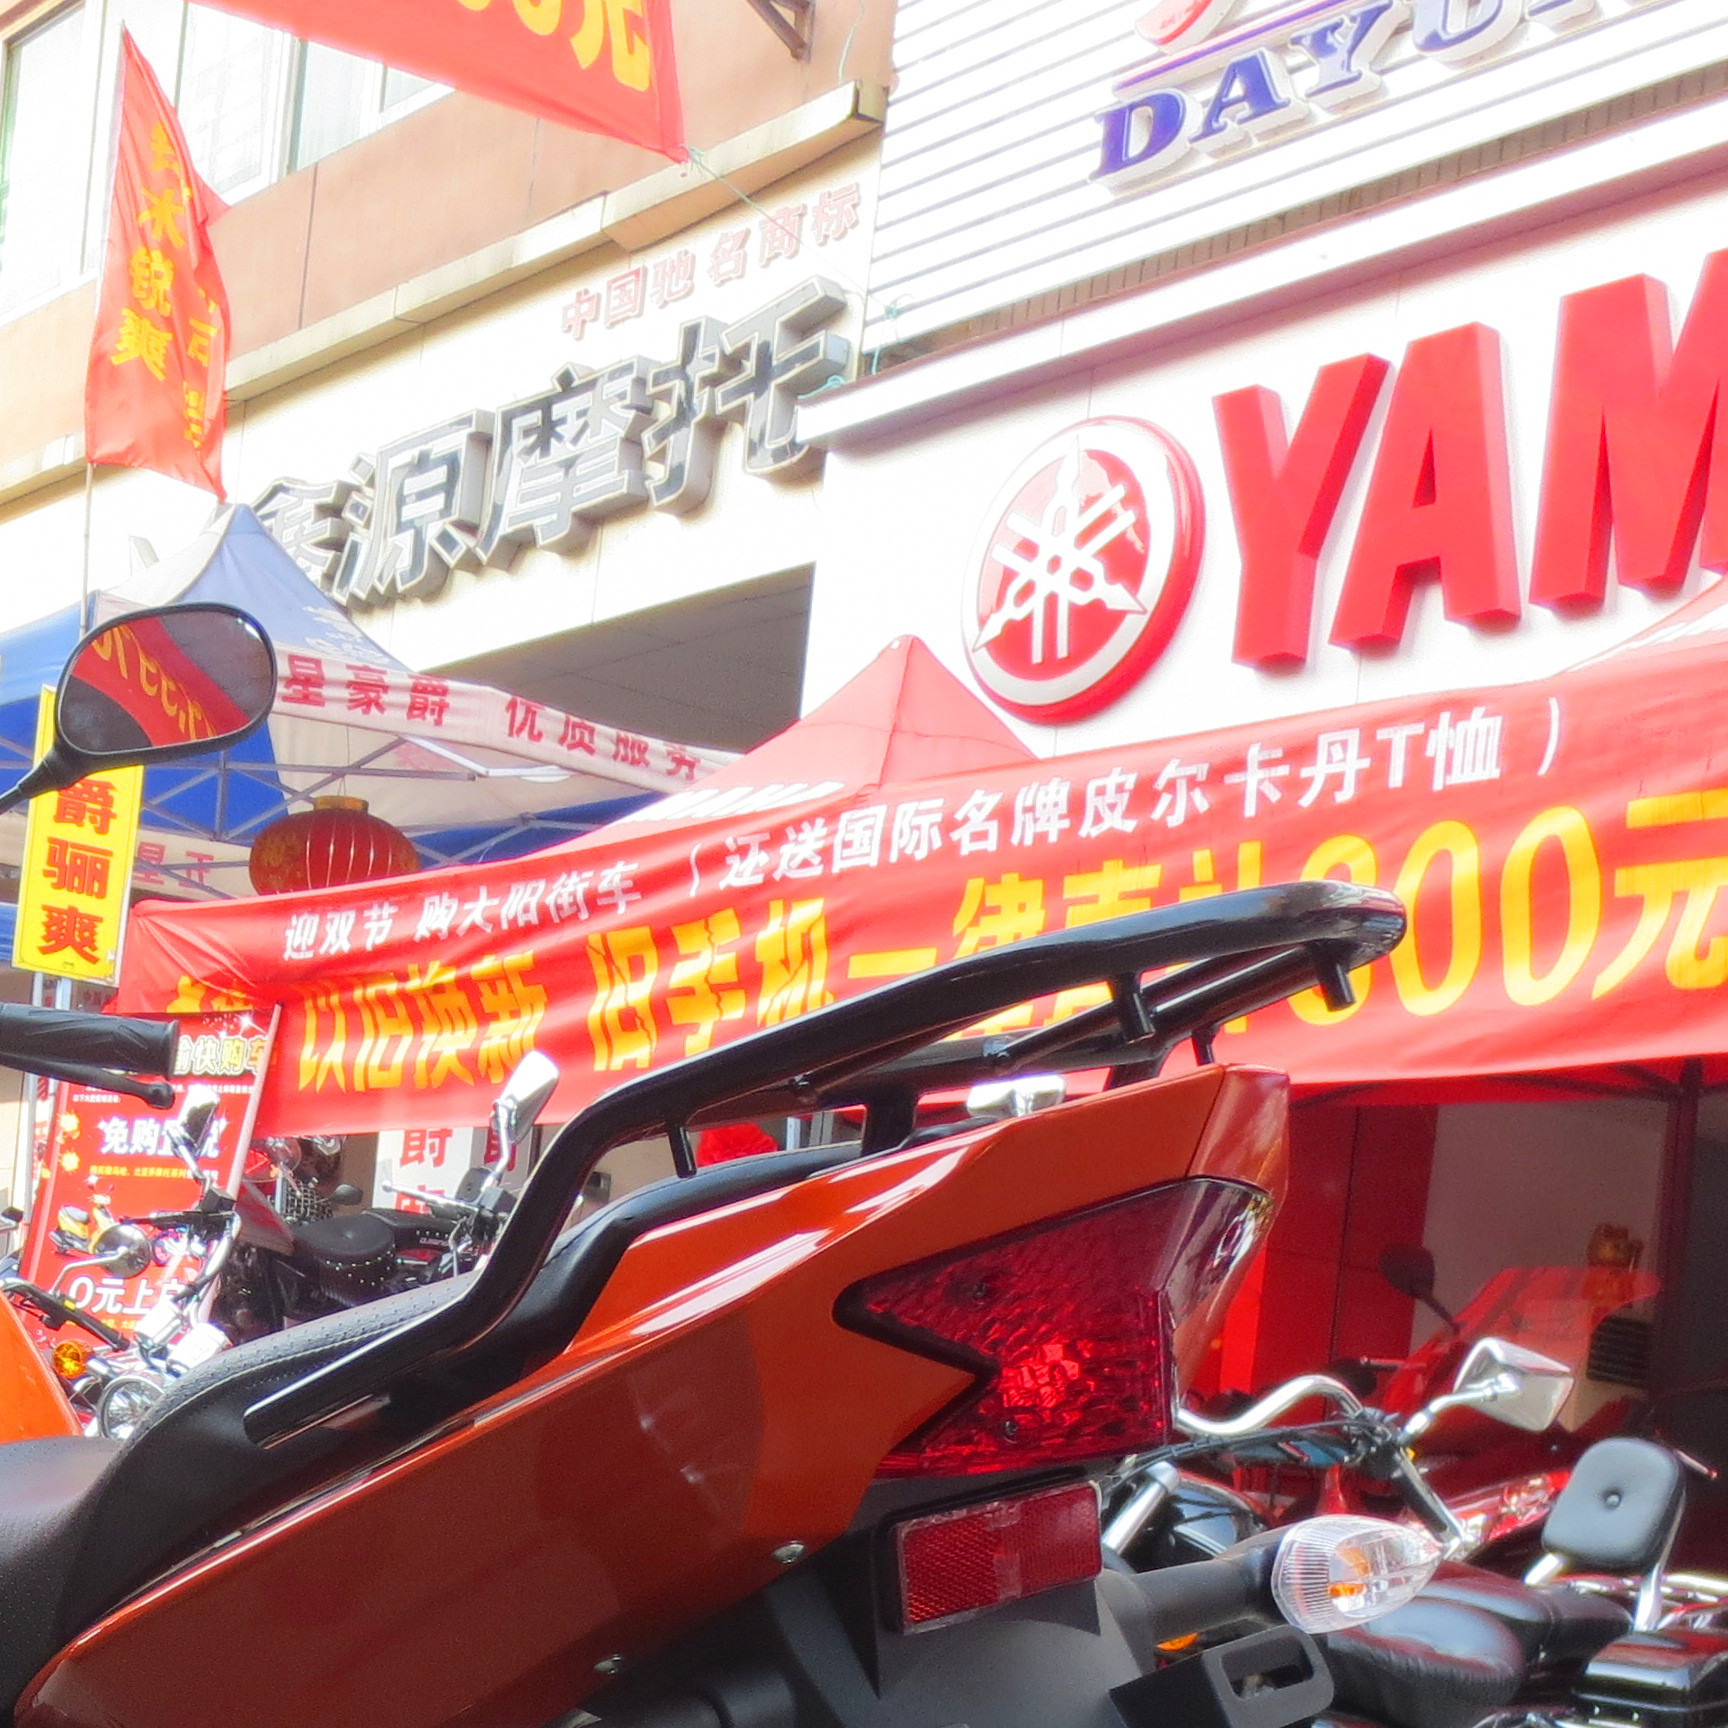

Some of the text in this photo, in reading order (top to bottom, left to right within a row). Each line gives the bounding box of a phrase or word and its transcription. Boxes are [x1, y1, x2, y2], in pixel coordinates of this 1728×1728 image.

[560, 182, 861, 342] 中国驰名商标
[506, 695, 702, 782] 优质服务
[282, 900, 400, 961] 迎双节
[414, 860, 643, 943] 购大阳街车
[298, 949, 548, 1092] 以旧换新
